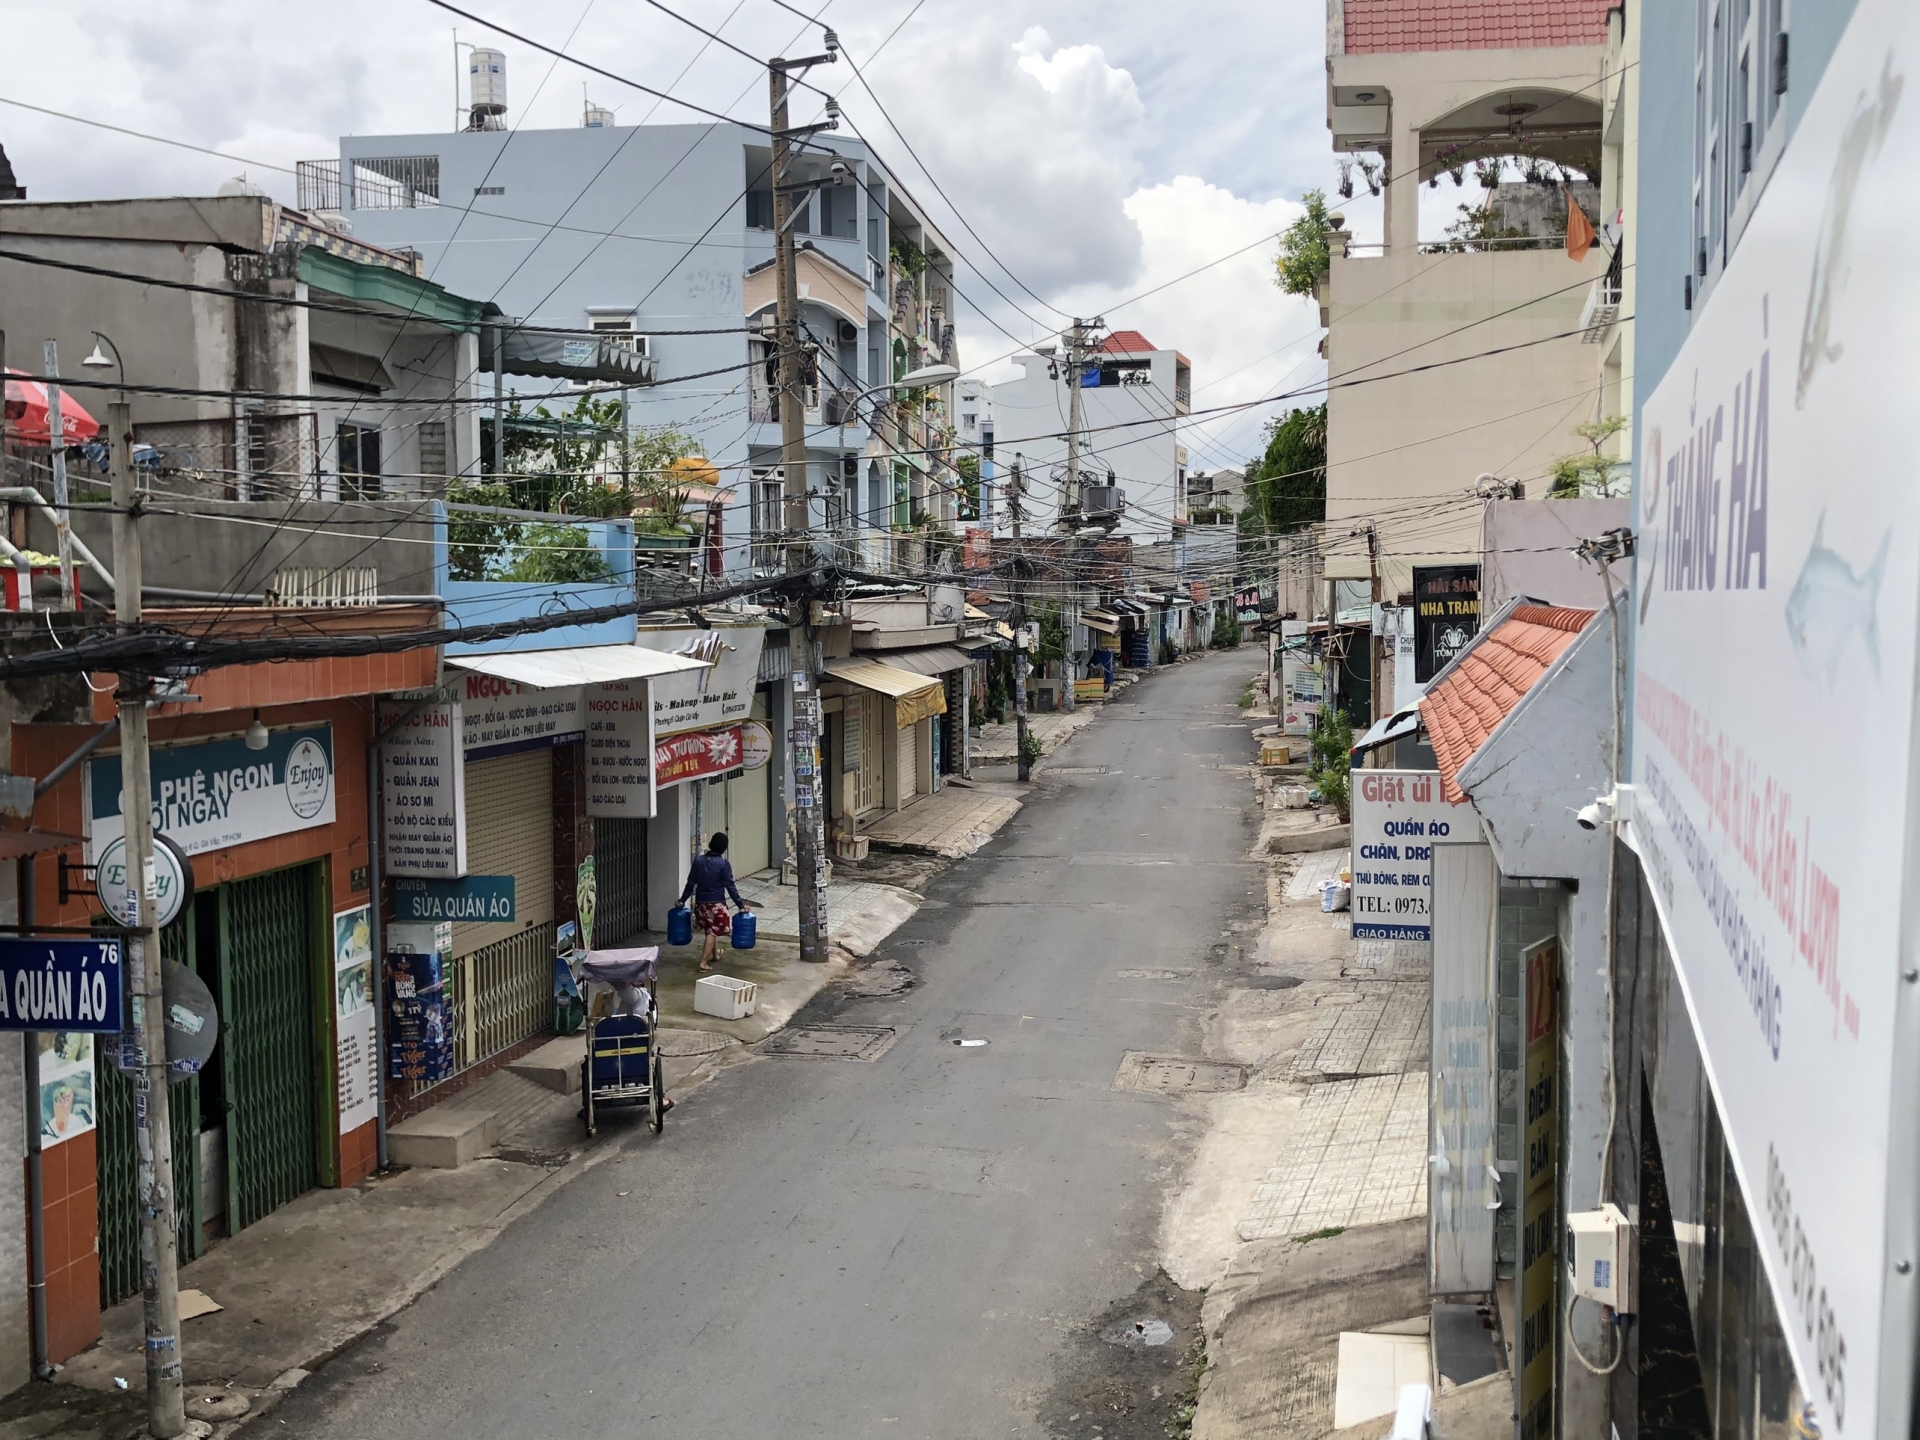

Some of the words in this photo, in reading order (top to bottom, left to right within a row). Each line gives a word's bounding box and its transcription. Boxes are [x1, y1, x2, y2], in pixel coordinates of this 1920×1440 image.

[1453, 577, 1477, 593] SẢN
[1420, 601, 1444, 616] NHA
[1435, 646, 1452, 658] TÔM
[602, 684, 614, 693] TẠP
[589, 700, 619, 715] NGỌC
[622, 698, 642, 712] HÂN
[669, 699, 698, 711] Makeup
[703, 695, 720, 705] Make
[722, 691, 737, 701] Hair
[424, 710, 449, 728] HÂN
[465, 715, 481, 728] NGỌT
[481, 729, 494, 741] MAY
[511, 724, 520, 738] ÁO
[545, 721, 556, 731] MAY
[420, 756, 439, 766] KAKI
[290, 762, 325, 790] Enjoy
[419, 776, 439, 787] JEAN
[160, 769, 206, 807] PHÊ
[213, 763, 274, 797] NGON
[1362, 775, 1404, 809] Giặt
[1413, 774, 1431, 803] ủi
[177, 787, 232, 828] NGÀY
[396, 792, 408, 806] ÁO
[410, 795, 422, 807] SƠ
[423, 796, 433, 807] MI
[407, 814, 418, 829] BỘ
[419, 814, 436, 826] CÁC
[1384, 816, 1424, 837] QUẦN
[1429, 819, 1450, 836] ÁO
[408, 834, 422, 842] MAY
[443, 832, 453, 843] ÁO
[404, 847, 424, 855] TRANG
[426, 847, 440, 855] NAM
[1360, 843, 1401, 861] CHĂN,
[396, 878, 427, 891] CHUYÊN
[1374, 870, 1399, 886] BÔNG,
[413, 889, 442, 918] SỬA
[445, 892, 485, 919] QUẦN
[489, 891, 510, 918] ÁO
[1357, 896, 1391, 913] TEL:
[1395, 898, 1430, 915] 0973.
[1356, 928, 1386, 939] GIAO
[1390, 926, 1425, 940] HÀNG
[99, 944, 118, 965] 76
[15, 950, 72, 1023] QUẦN
[78, 956, 107, 1022] ÁO
[1527, 946, 1556, 1044] 123
[1750, 935, 1782, 1062] HÀNG
[401, 1050, 426, 1064] Tiger
[401, 1065, 426, 1079] Tiger
[1524, 1220, 1535, 1272] BIA
[1537, 1203, 1555, 1257] CHAI
[1524, 1314, 1535, 1368] BIA
[1537, 1299, 1550, 1354] LON
